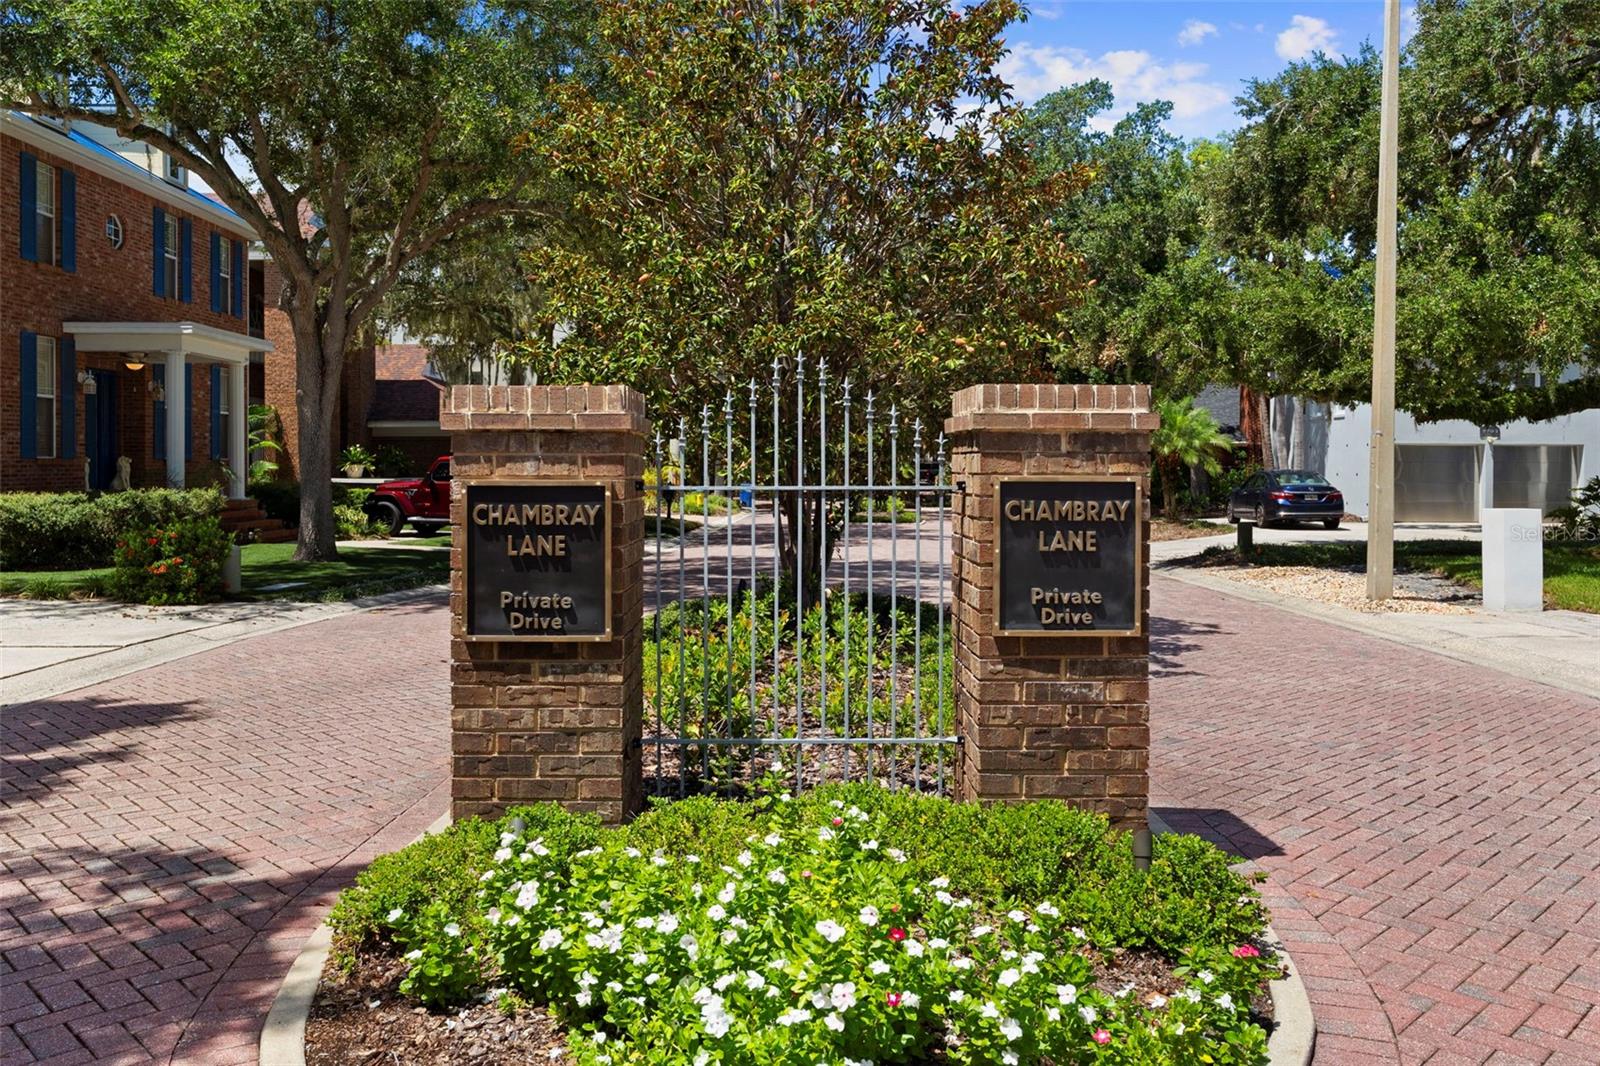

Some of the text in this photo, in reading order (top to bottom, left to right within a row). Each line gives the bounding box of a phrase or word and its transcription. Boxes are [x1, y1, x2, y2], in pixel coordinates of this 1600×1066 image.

[472, 504, 600, 526] CHAMBRAY
[1005, 500, 1130, 521] CHAMBRAY
[507, 535, 566, 556] LANE
[1039, 531, 1097, 551] LANE
[500, 591, 572, 609] Private
[1031, 587, 1102, 605] Private
[510, 612, 562, 629] Drive
[1041, 608, 1093, 625] Drive
